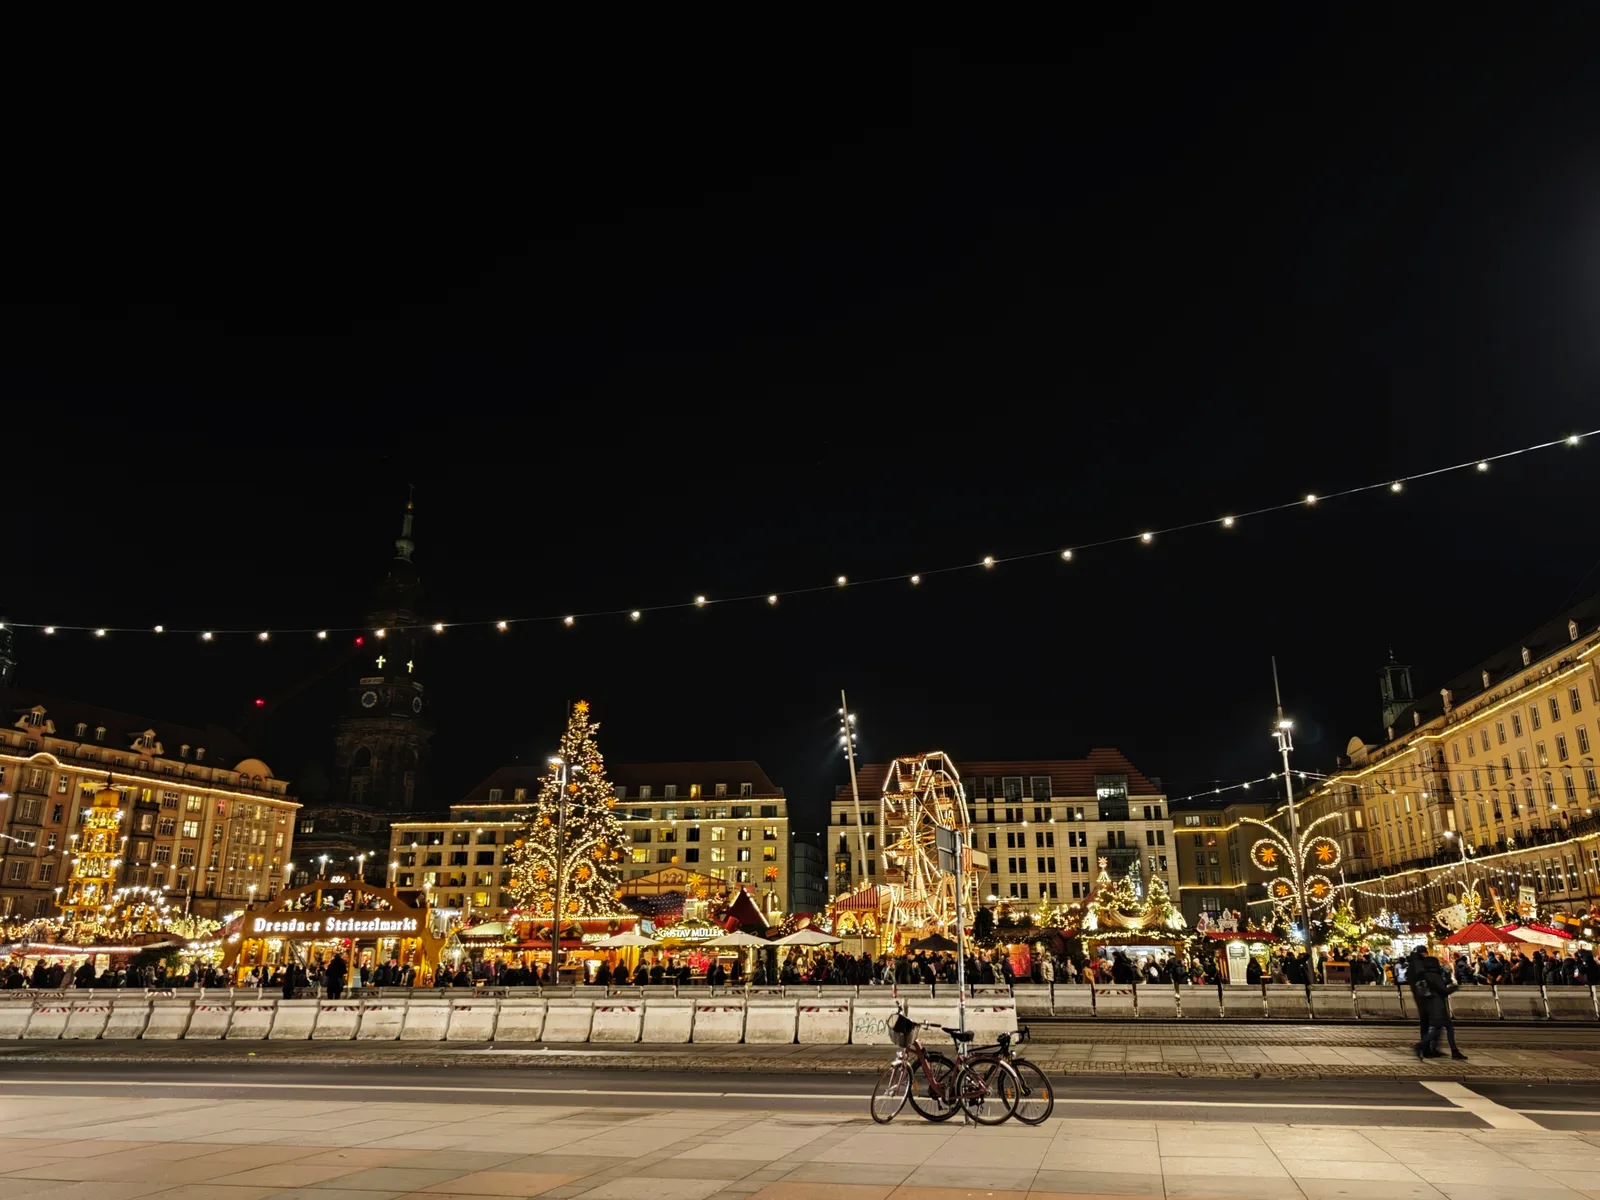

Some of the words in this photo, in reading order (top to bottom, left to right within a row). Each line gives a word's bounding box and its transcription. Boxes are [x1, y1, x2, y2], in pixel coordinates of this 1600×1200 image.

[254, 917, 320, 932] Dresdner
[325, 917, 418, 932] Striezelmarkt
[660, 929, 691, 938] GUSTAV
